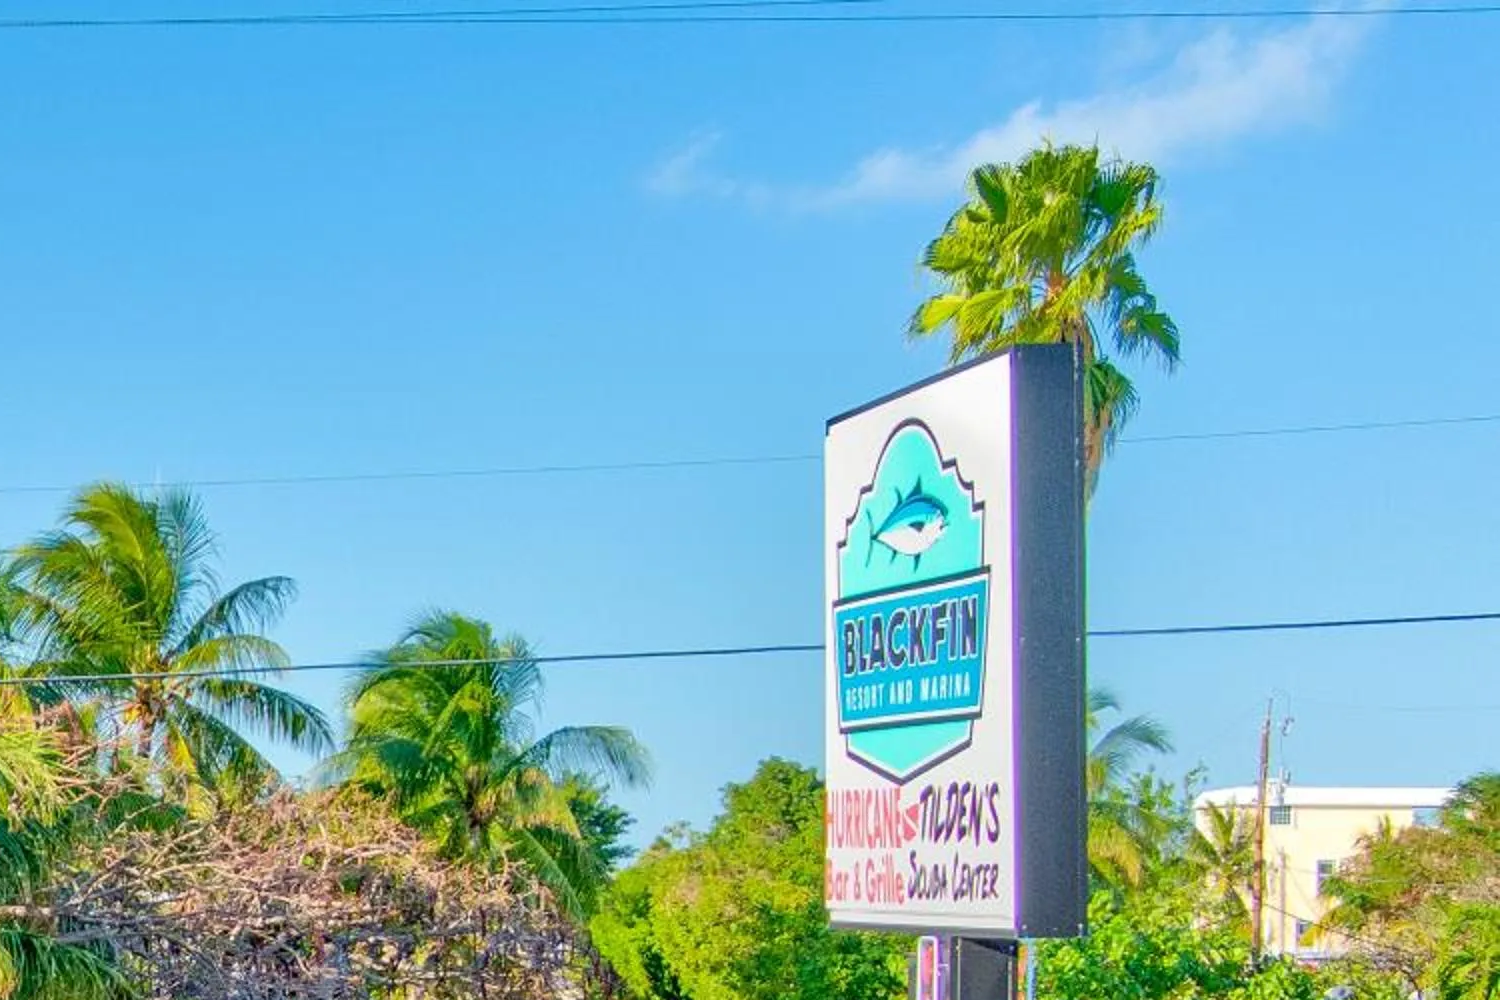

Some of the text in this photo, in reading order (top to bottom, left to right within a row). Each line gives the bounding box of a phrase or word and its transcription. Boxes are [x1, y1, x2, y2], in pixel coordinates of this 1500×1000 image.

[842, 594, 980, 677] BLACKFIN
[845, 671, 971, 712] RESORT AND MARINA
[825, 788, 903, 849] HURRICANE
[919, 781, 999, 848] TILDEN'S
[825, 859, 849, 901] Bar
[866, 853, 905, 904] Grille
